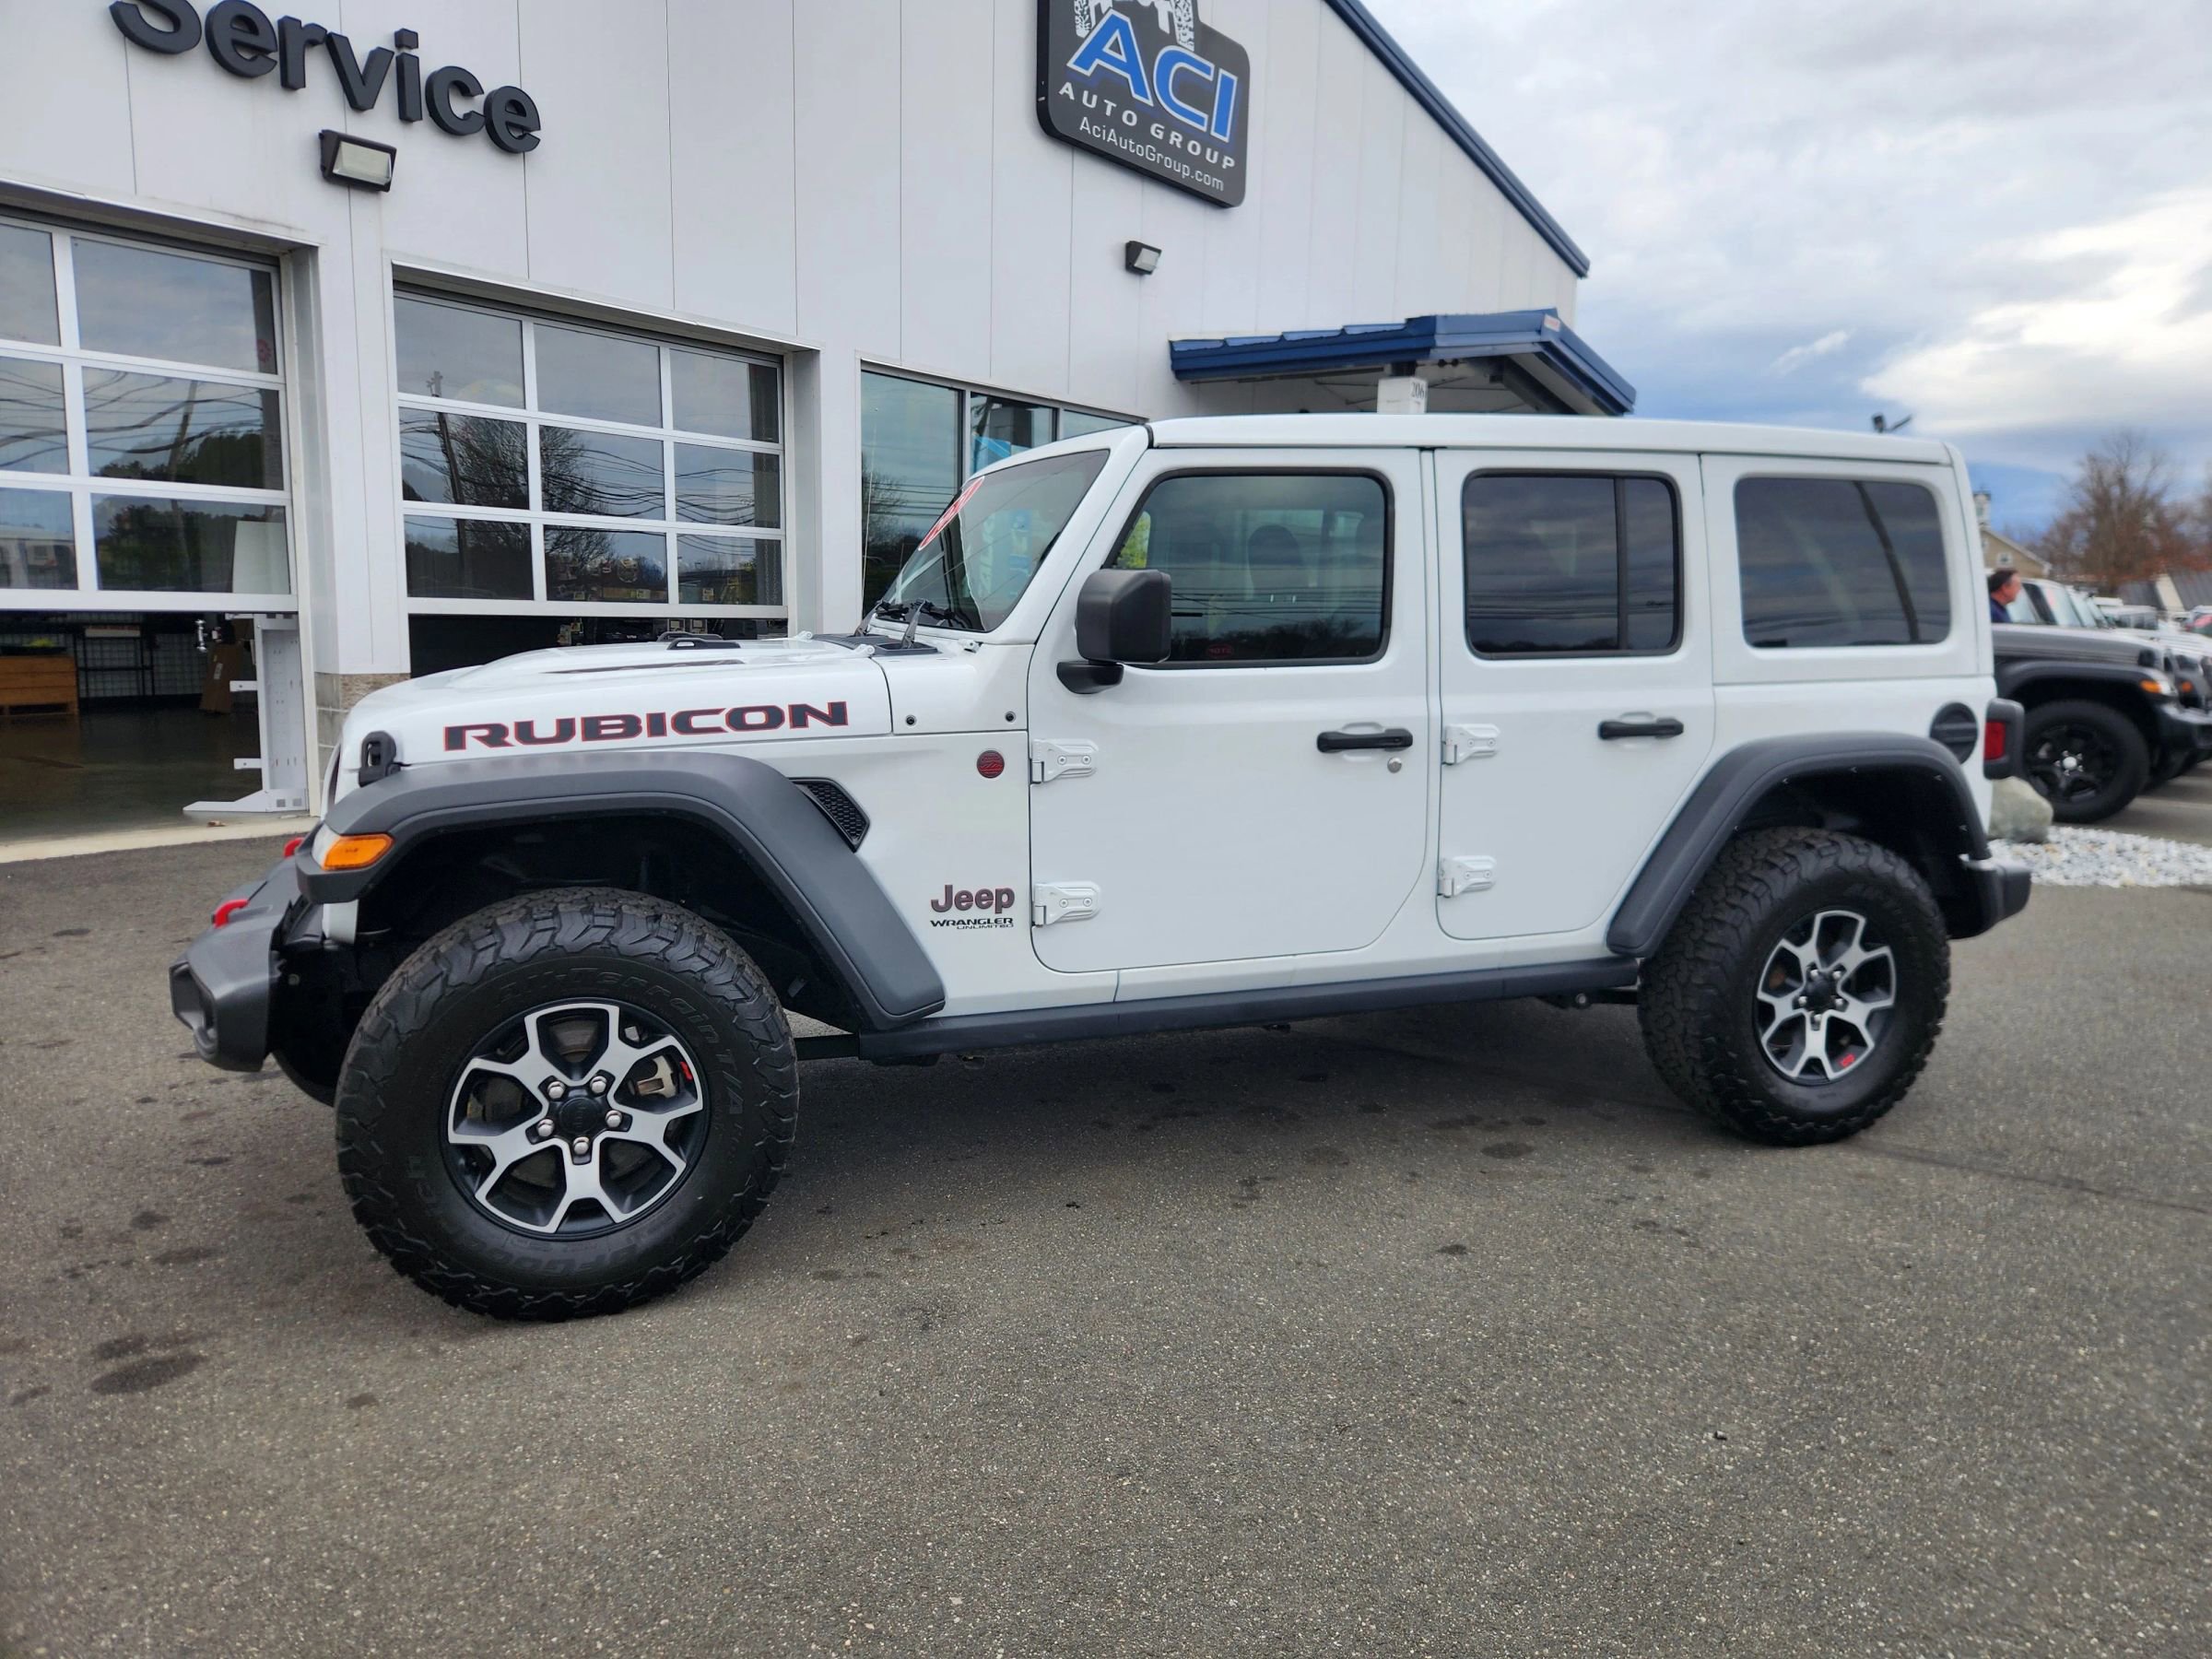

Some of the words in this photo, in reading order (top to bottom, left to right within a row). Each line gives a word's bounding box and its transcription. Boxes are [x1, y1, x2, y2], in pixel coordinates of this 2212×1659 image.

[110, 0, 541, 154] Service
[1066, 8, 1239, 143] ACI
[1059, 81, 1138, 126] AUTO
[1150, 123, 1236, 170] GROUP
[1079, 116, 1225, 192] AciAutoGroup.com
[443, 700, 849, 752] RUBICON
[930, 884, 1016, 914] Jeep
[930, 917, 1013, 927] WRANGLER
